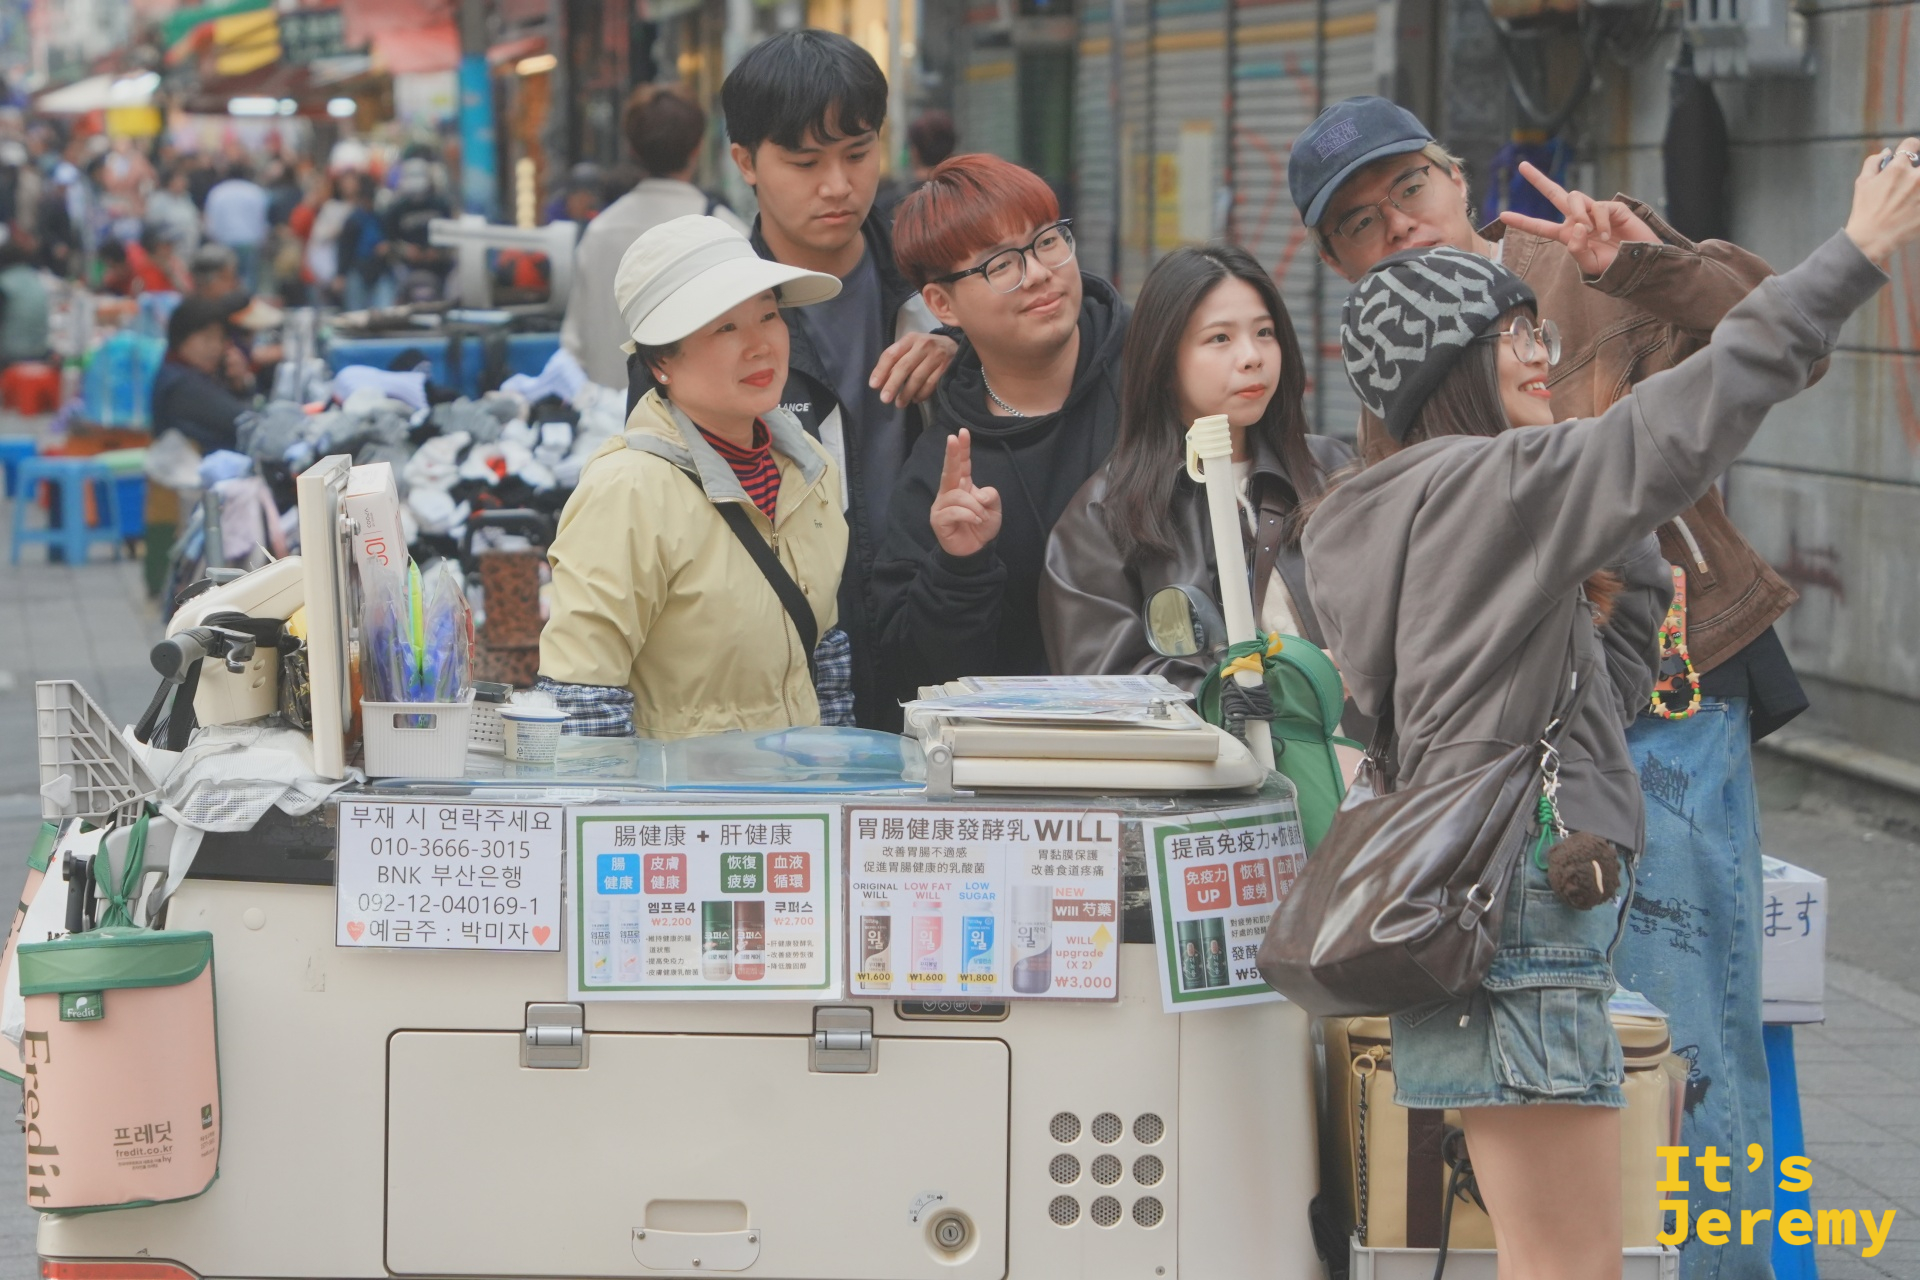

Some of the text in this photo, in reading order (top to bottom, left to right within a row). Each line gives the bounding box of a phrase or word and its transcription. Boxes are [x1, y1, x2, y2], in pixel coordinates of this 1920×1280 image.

[350, 806, 552, 832] 부재 시 연락주세요
[614, 824, 687, 847] 腸健康
[720, 823, 793, 846] 肝健康
[858, 817, 1112, 842] 胃腸健康發酵乳 WILL
[371, 837, 530, 859] 010-3666-3015
[882, 846, 968, 858] 改善胃腸不適感
[611, 857, 625, 870] 腸
[650, 856, 679, 870] 皮膚
[727, 856, 757, 870] 恢復
[774, 856, 804, 870] 血液
[864, 861, 985, 874] 促進胃腸健康的乳酸菌
[1031, 864, 1104, 876] 改善食道疼痛
[1186, 867, 1227, 886] 免疫力
[1240, 862, 1265, 880] 恢復
[378, 865, 522, 889] BNK 부산은행
[604, 876, 633, 890] 健康
[650, 875, 680, 889] 健康
[727, 874, 756, 889] 疲勞
[774, 874, 804, 889] 循環
[853, 882, 898, 890] ORIGINAL
[904, 882, 952, 891] LOW FAT
[965, 882, 990, 890] LOW
[1055, 888, 1085, 897] NEW
[1242, 882, 1267, 900] 疲勞
[863, 891, 888, 899] WILL
[916, 891, 940, 899] WILL
[959, 892, 996, 900] SUGAR
[1197, 889, 1221, 904] UP
[358, 893, 538, 915] 092-12-040169-1
[648, 902, 696, 914] 엠프로4
[774, 901, 813, 913] 쿠퍼스
[1055, 905, 1079, 917] Will
[1764, 892, 1817, 937] ます
[651, 917, 692, 926] ₩2,200
[774, 917, 814, 926] ₩2,700
[369, 920, 436, 943] 예금주
[461, 922, 529, 945] 박미자
[1066, 936, 1094, 945] WILL
[1055, 949, 1103, 959] upgrade
[857, 973, 891, 981] ₩1,600
[909, 973, 943, 982] ₩1,600
[960, 974, 994, 982] ₩1,800
[1054, 976, 1112, 989] ₩3,000
[67, 1007, 95, 1018] Fredit
[25, 1030, 60, 1204] Fredit
[113, 1121, 173, 1146] 프레딧
[115, 1145, 173, 1158] fredit.co.kr
